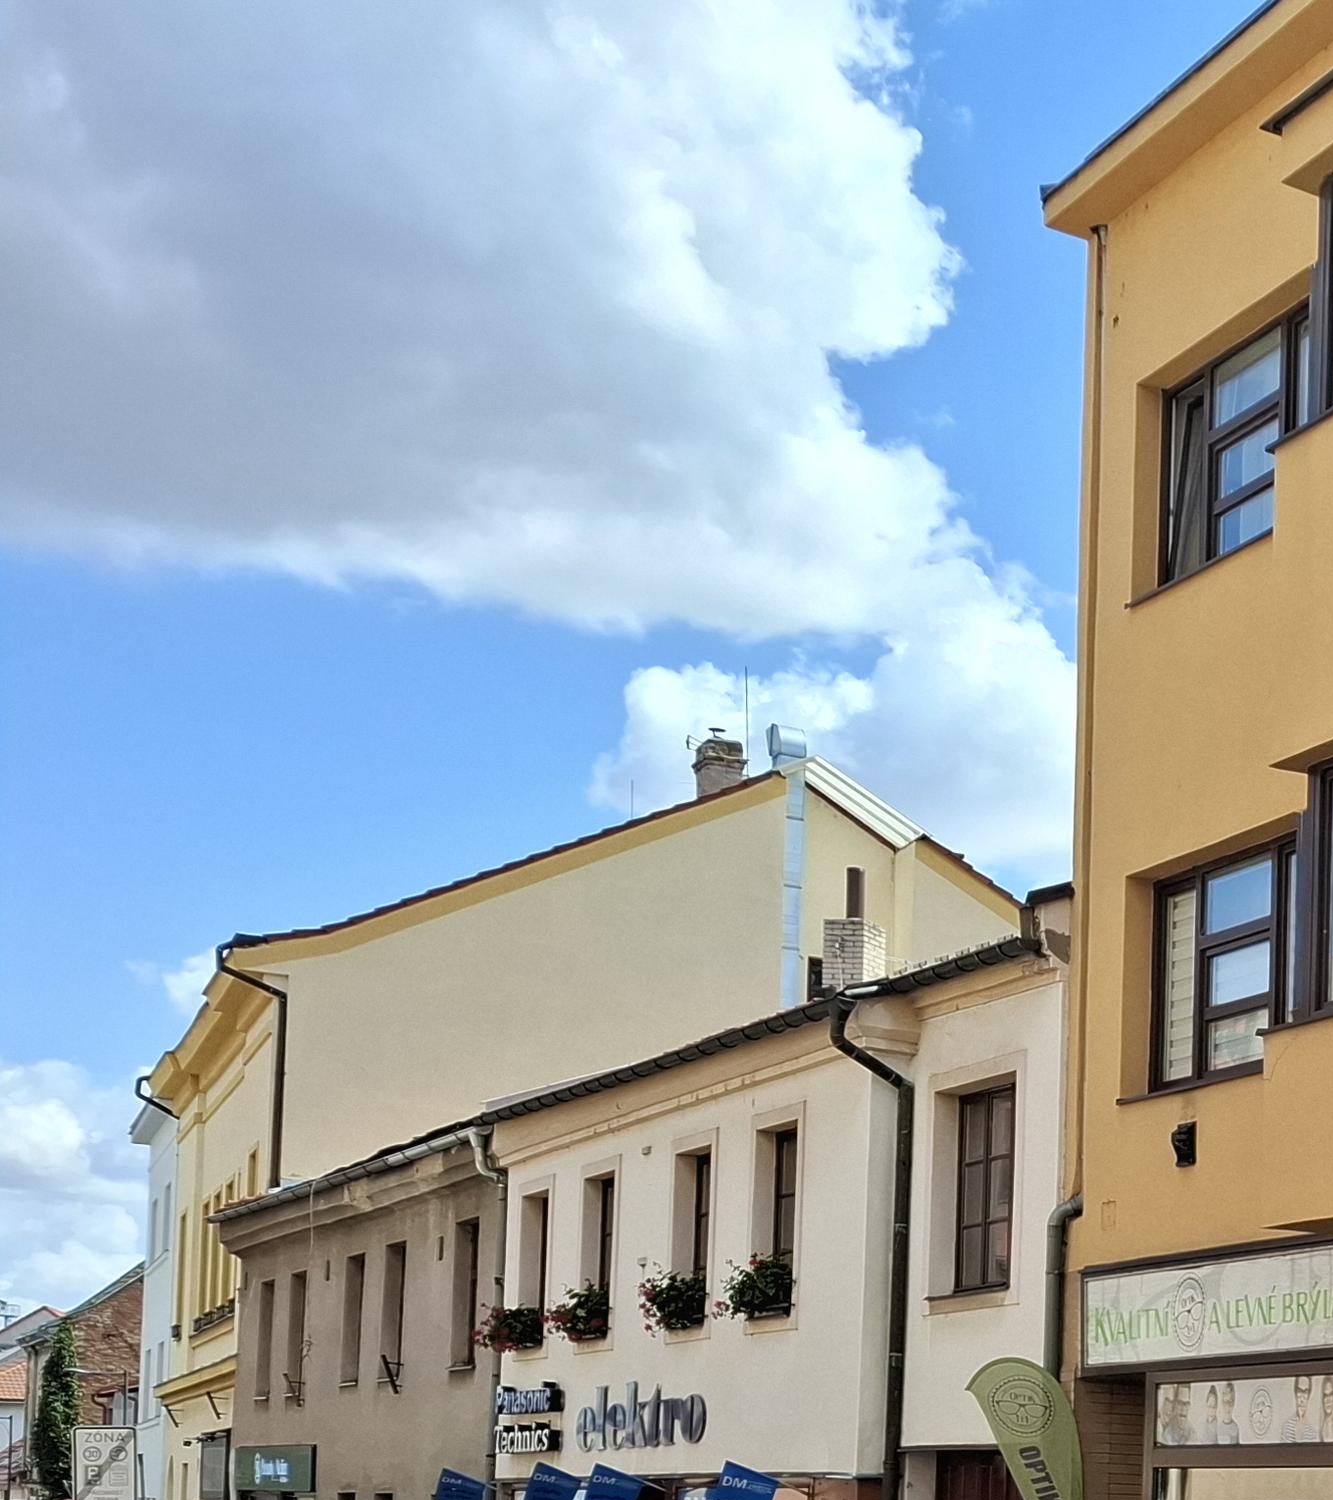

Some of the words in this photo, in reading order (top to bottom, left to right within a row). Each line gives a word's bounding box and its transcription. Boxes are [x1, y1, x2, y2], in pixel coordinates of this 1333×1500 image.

[1094, 1300, 1171, 1346] KVALITNÍ
[1208, 1302, 1222, 1334] A
[1226, 1285, 1277, 1330] LEVNÉ
[496, 1385, 551, 1414] Panasonic
[576, 1381, 708, 1452] elektro
[494, 1422, 549, 1454] Technics
[722, 1476, 747, 1489] DM
